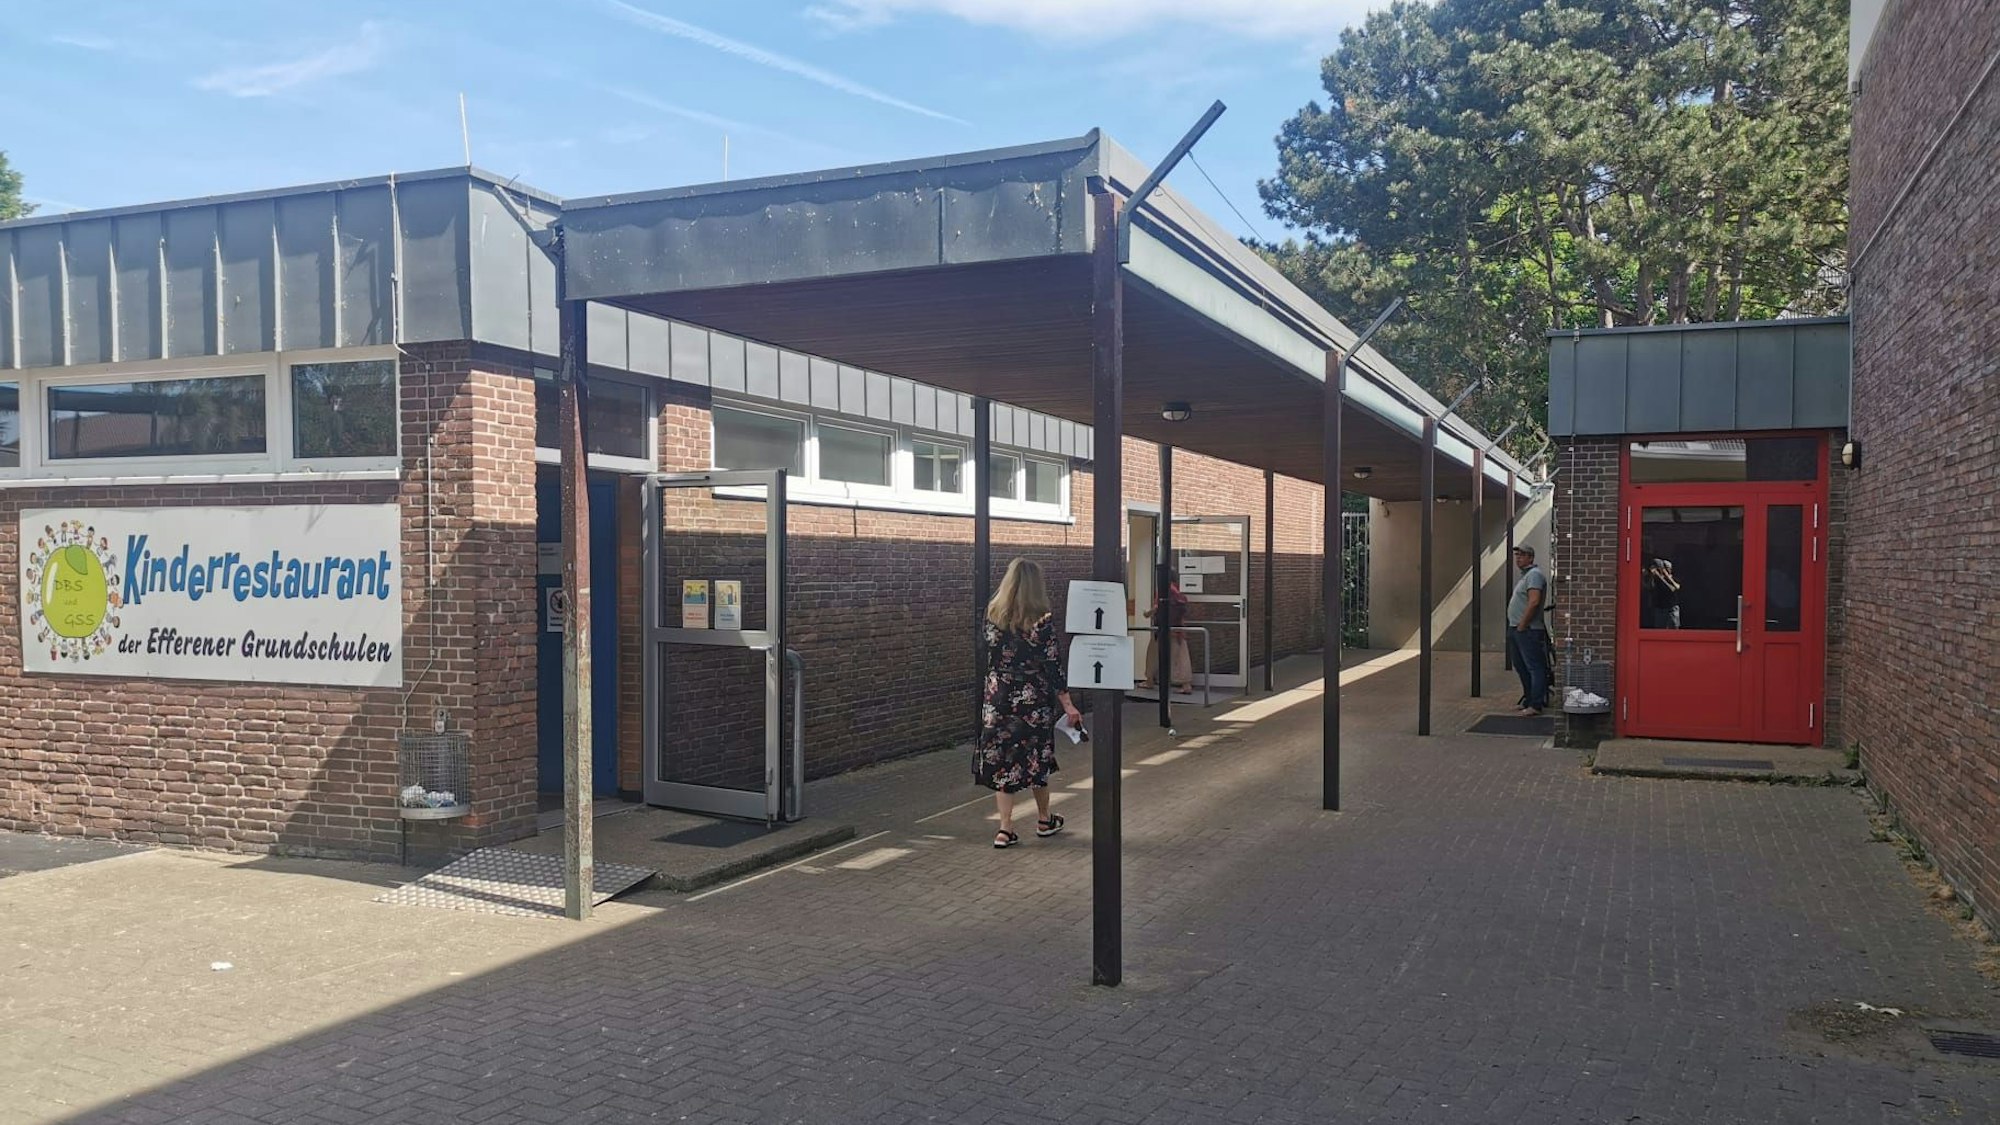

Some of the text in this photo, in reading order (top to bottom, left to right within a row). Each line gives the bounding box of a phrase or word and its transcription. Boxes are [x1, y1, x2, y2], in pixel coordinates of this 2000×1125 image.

[123, 534, 392, 605] Kinderrestaurant
[55, 579, 83, 591] DBS
[64, 614, 96, 628] GSS
[117, 627, 392, 662] der Efferener Grundschulen
